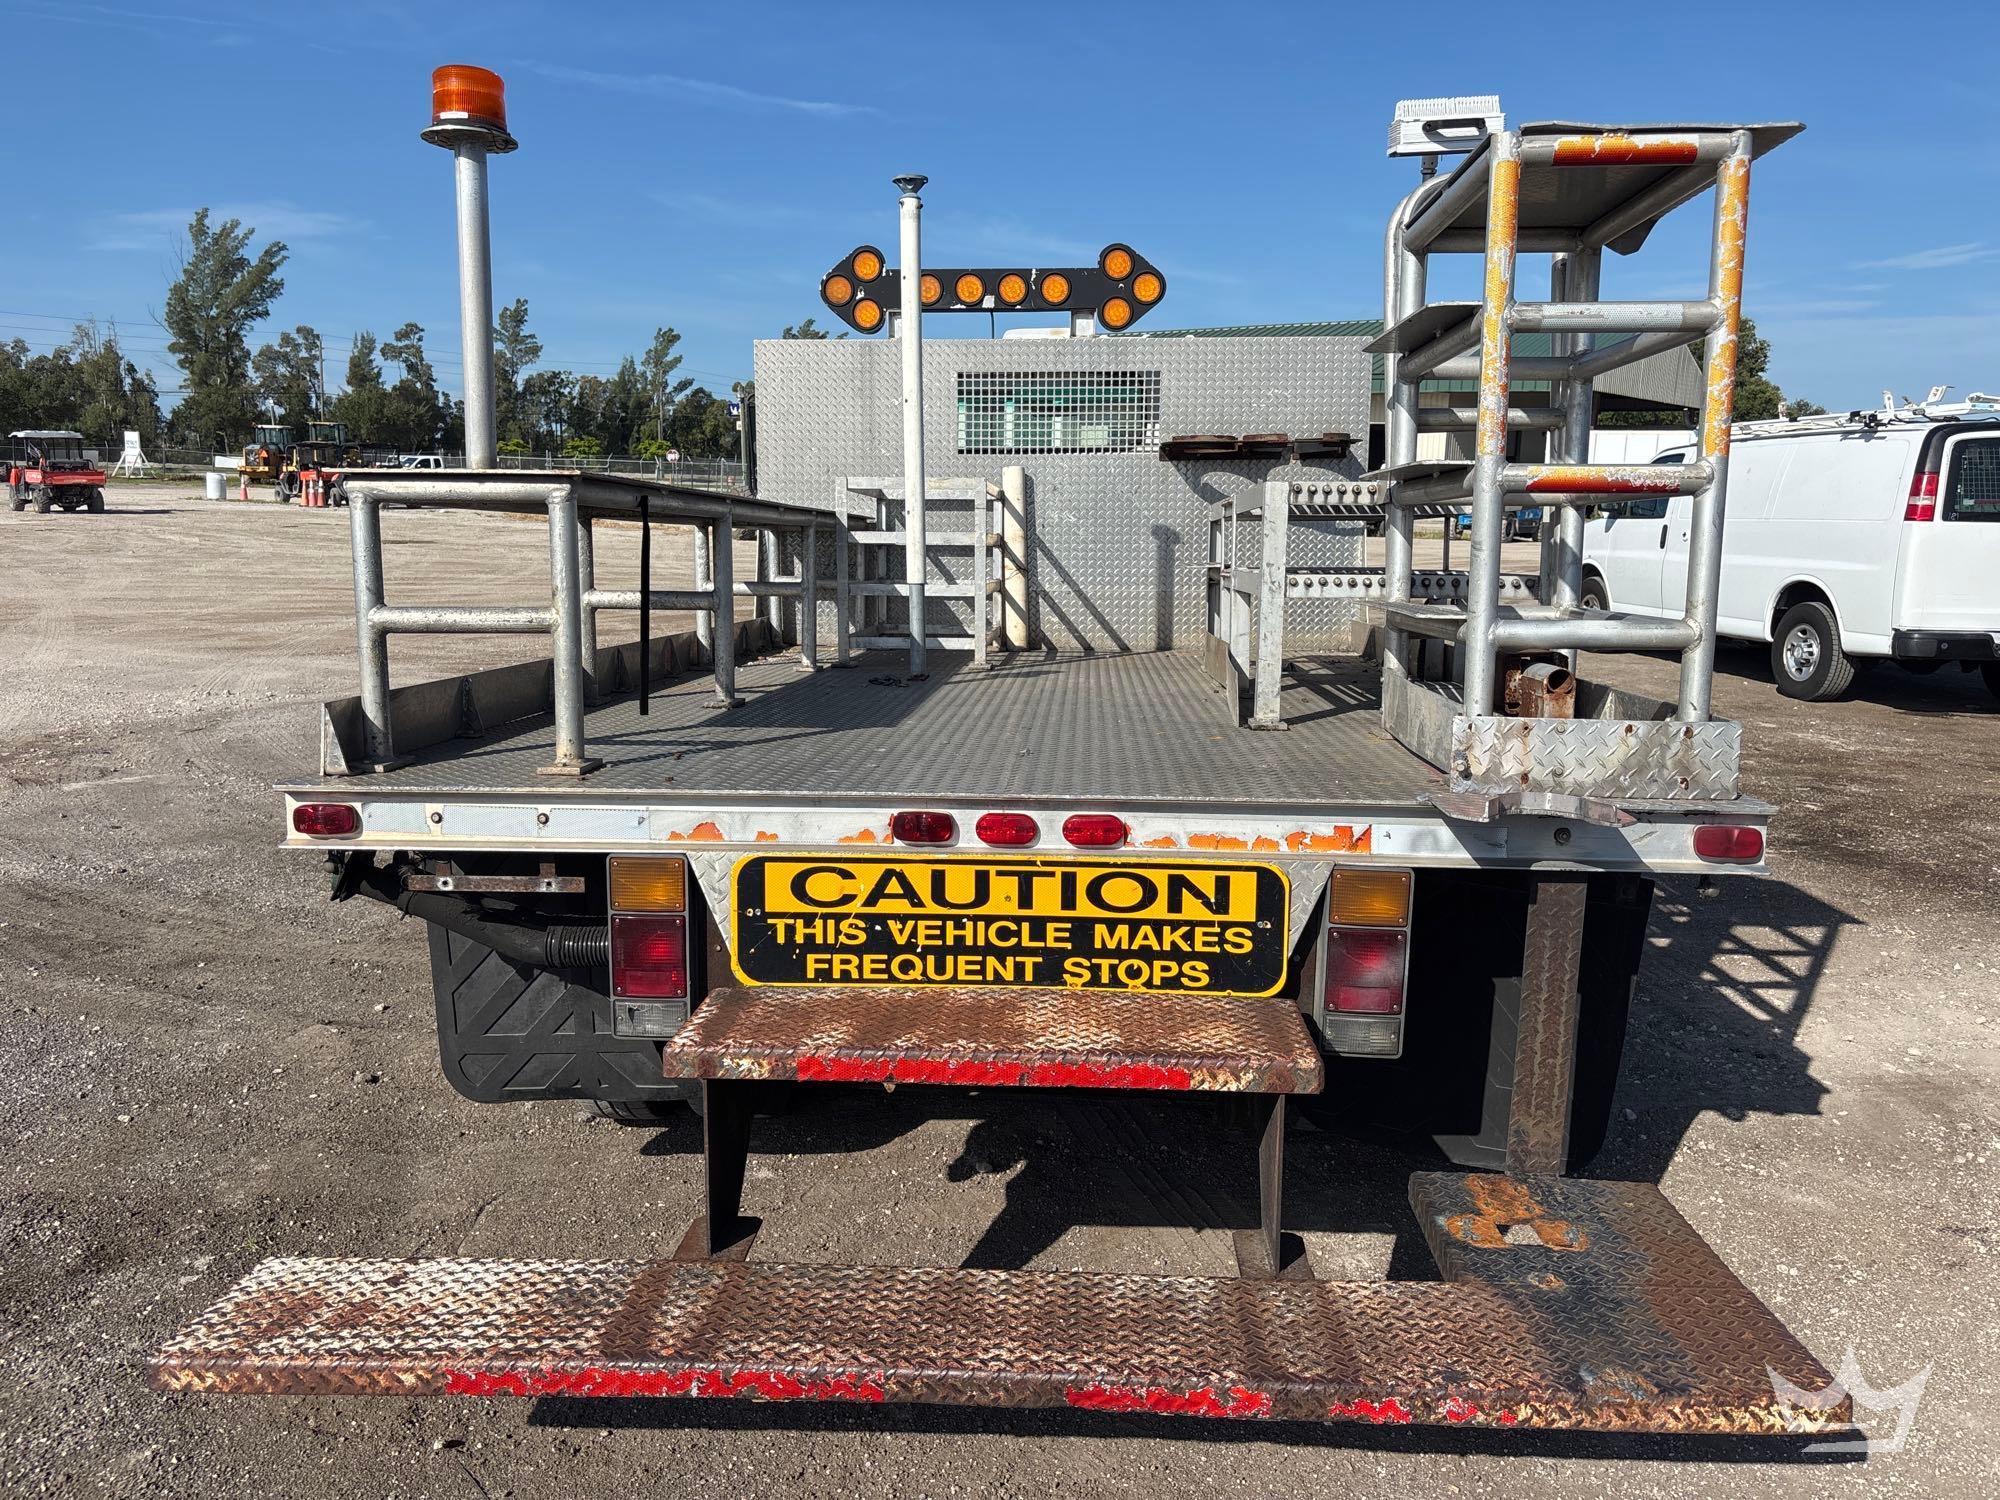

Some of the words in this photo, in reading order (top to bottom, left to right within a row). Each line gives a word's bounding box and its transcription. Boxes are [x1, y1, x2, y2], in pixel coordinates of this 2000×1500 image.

[790, 866, 1231, 915] CAUTION
[767, 918, 867, 946] THIS
[887, 919, 1072, 949] VEHICLE
[1094, 923, 1253, 954] MAKES
[806, 953, 1043, 982] FREQUENT
[1063, 957, 1210, 988] STOPS
